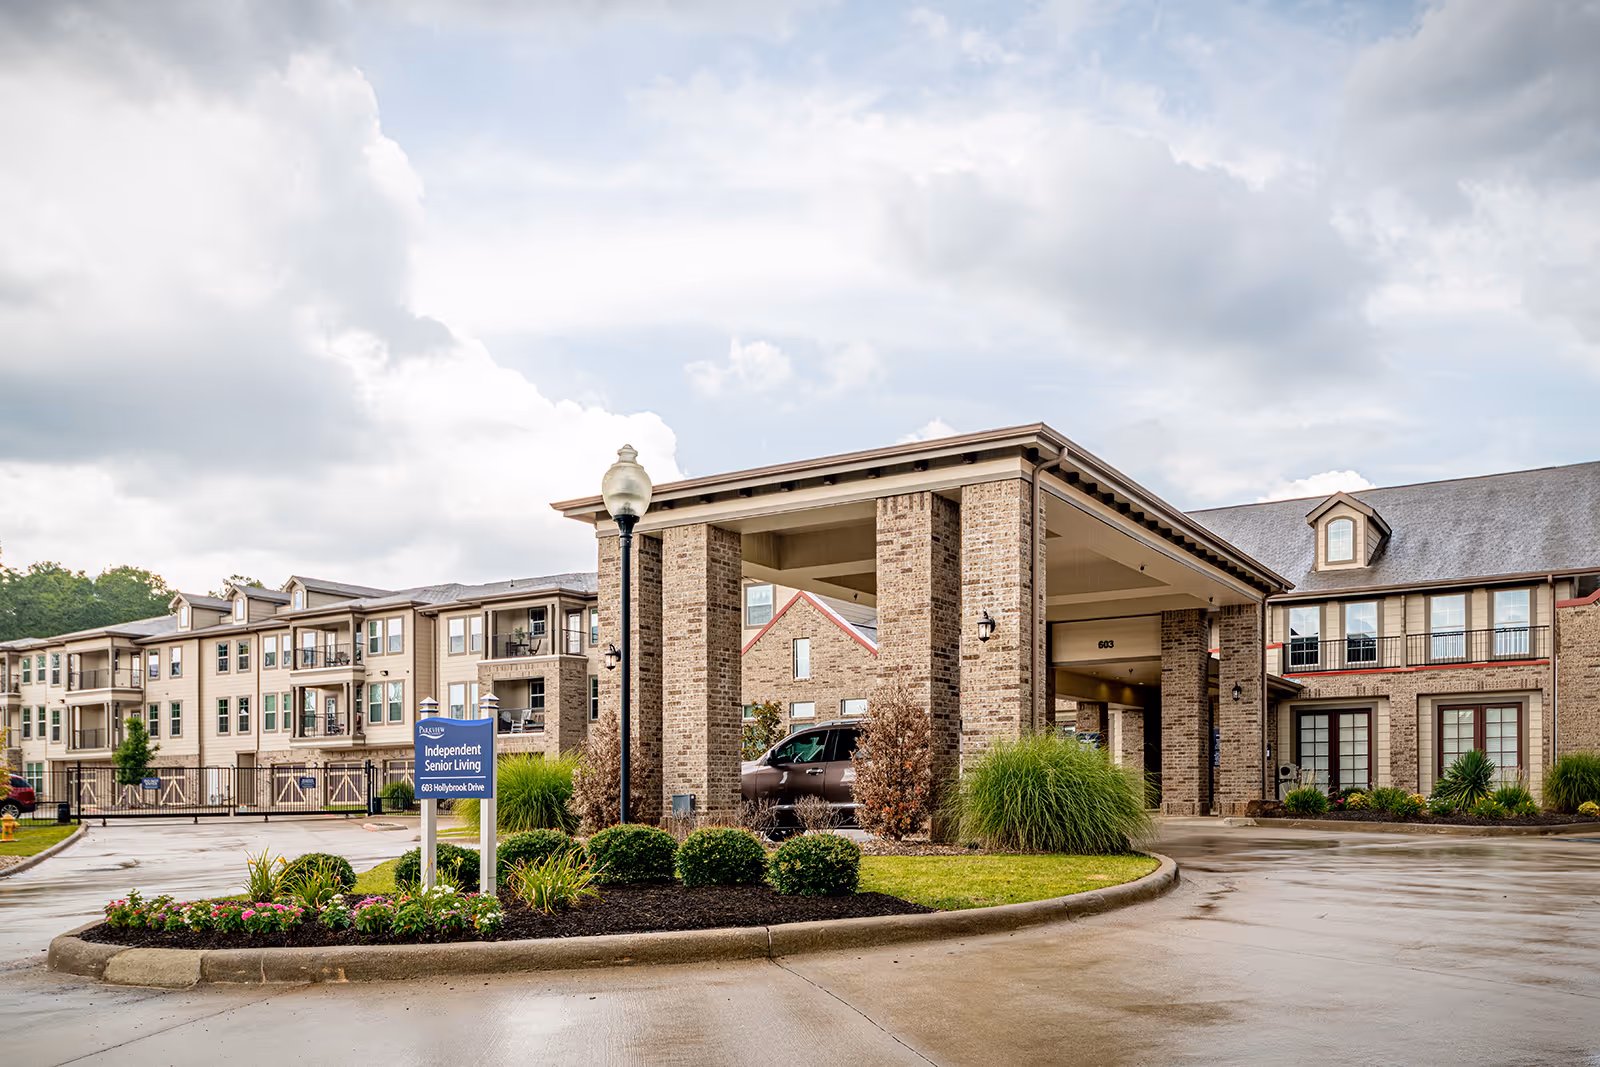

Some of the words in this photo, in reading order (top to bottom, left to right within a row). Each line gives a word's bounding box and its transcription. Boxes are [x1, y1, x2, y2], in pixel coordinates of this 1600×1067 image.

[1098, 640, 1114, 649] 603
[425, 743, 482, 759] Independent
[424, 759, 453, 772] Senior
[454, 759, 481, 773] Living
[421, 783, 433, 792] 603
[433, 783, 467, 794] Hollybrook
[467, 782, 485, 792] Drive
